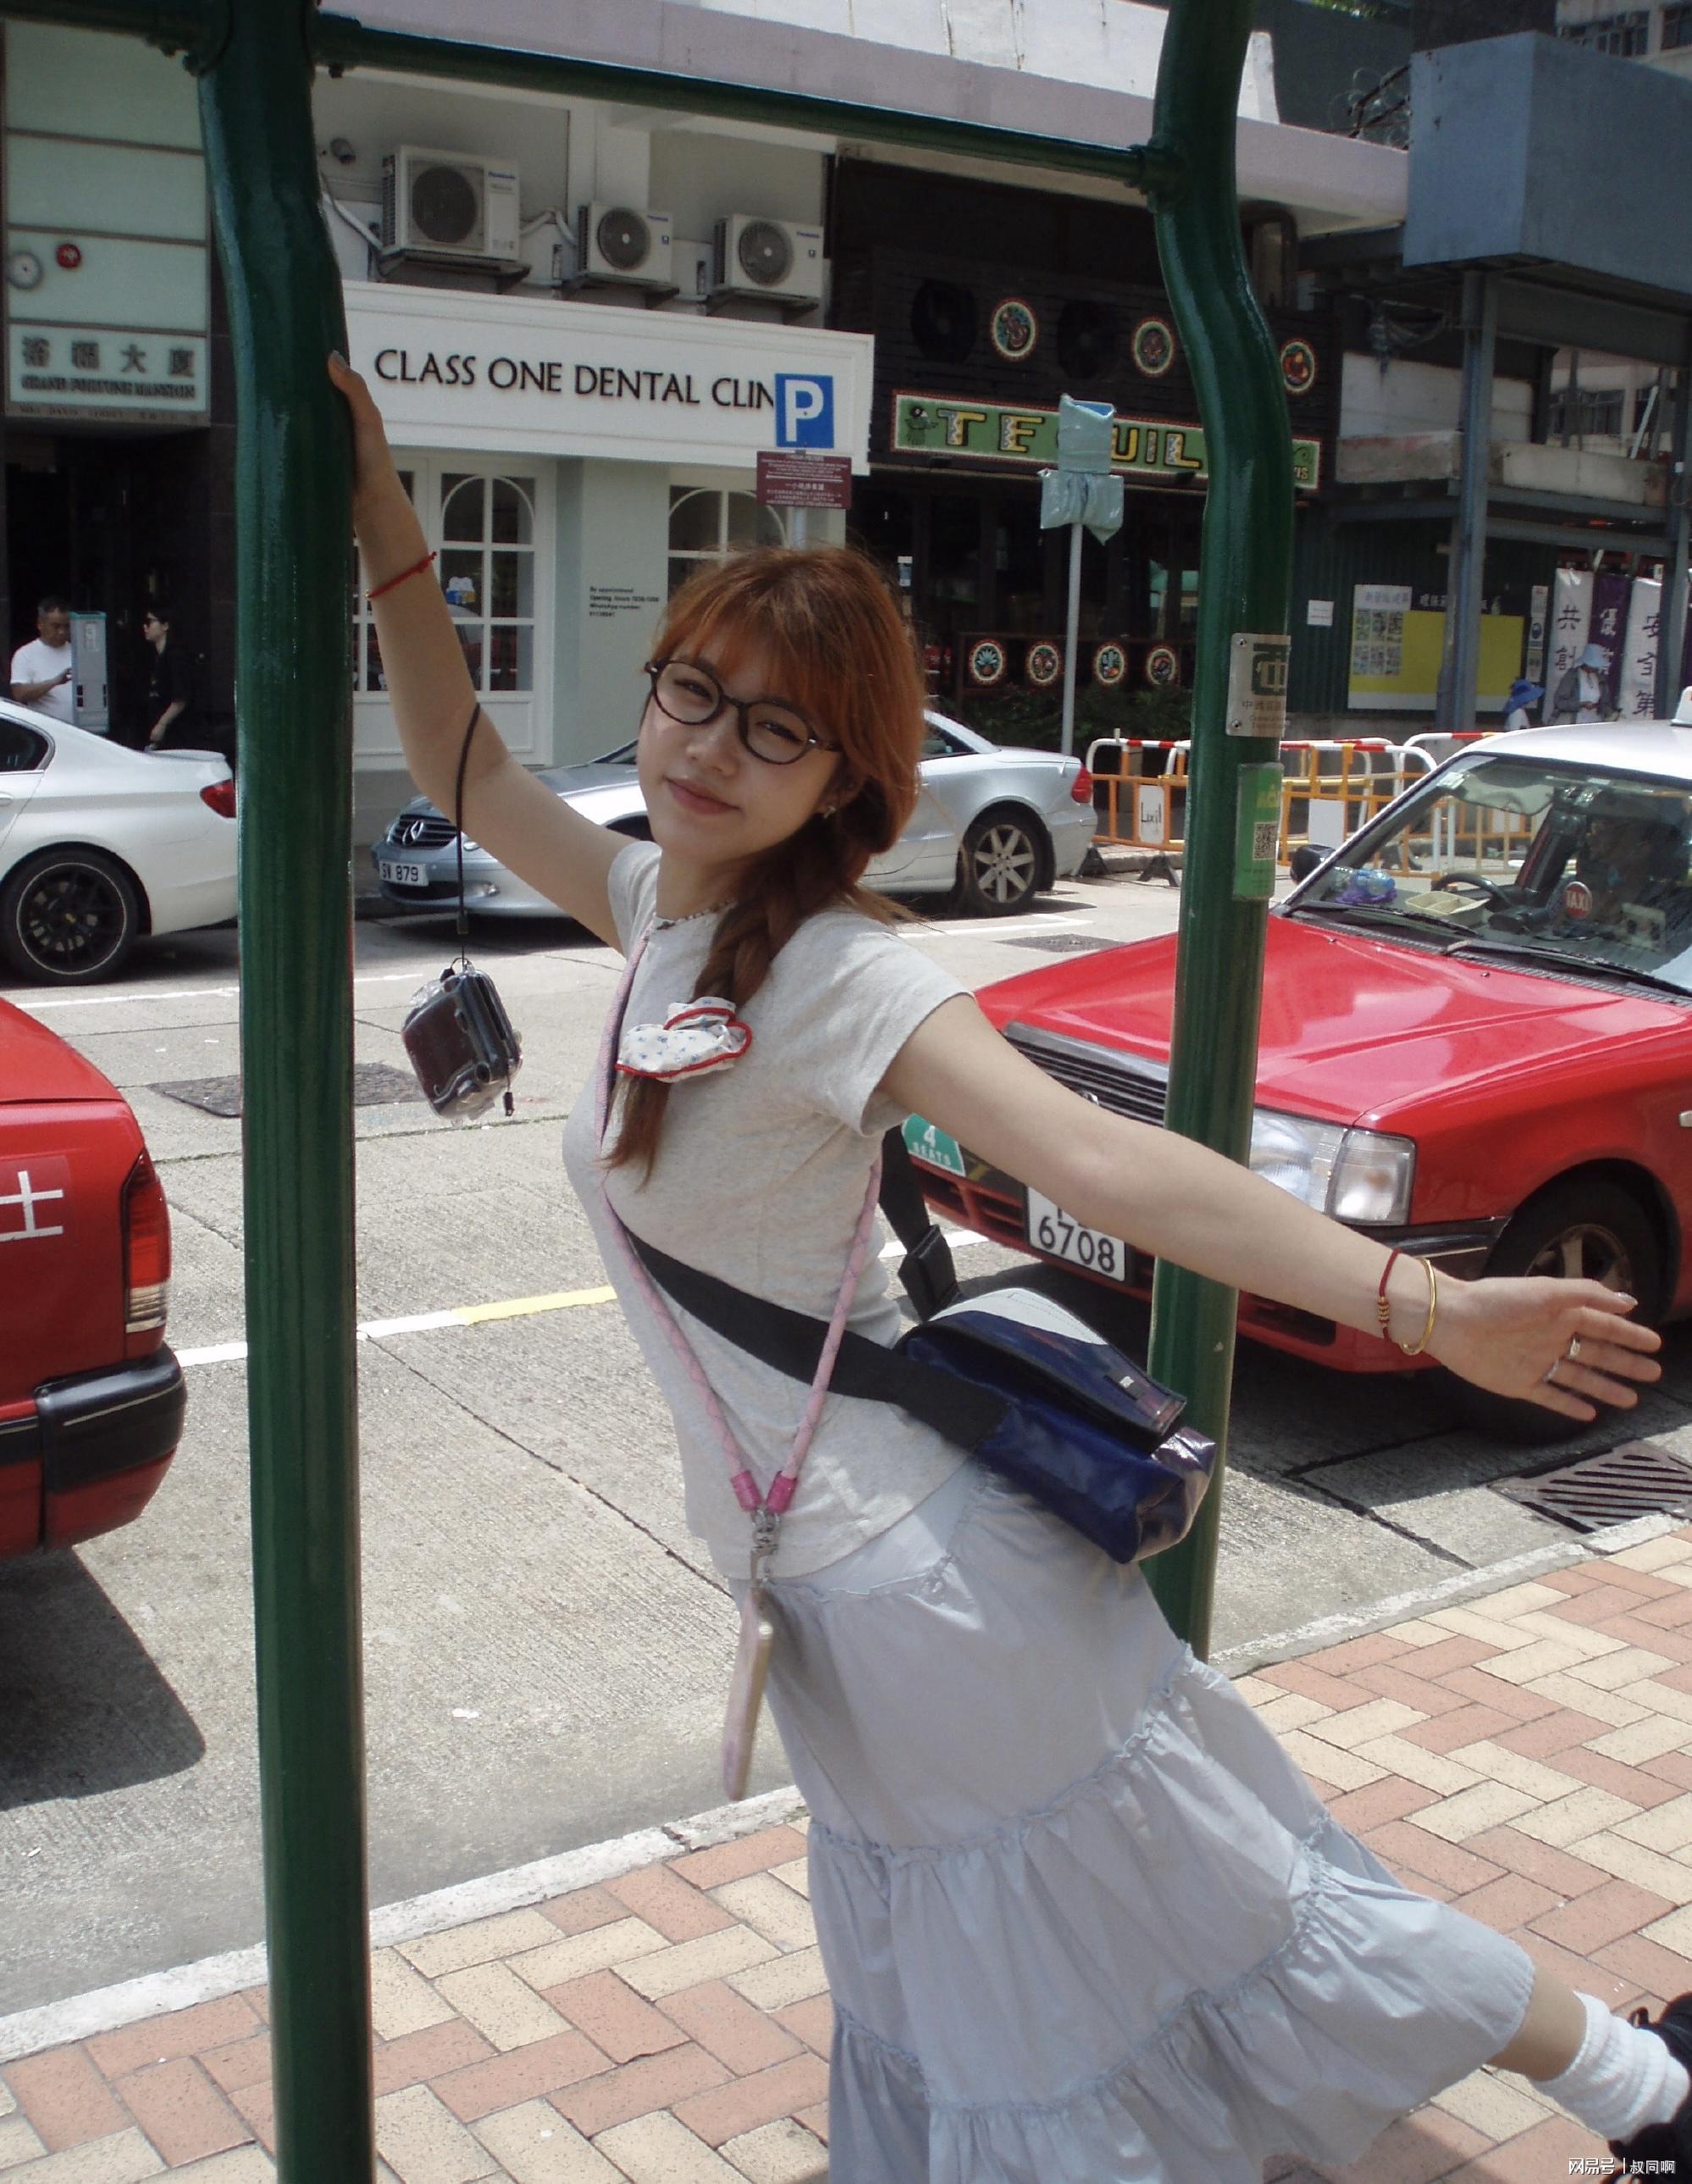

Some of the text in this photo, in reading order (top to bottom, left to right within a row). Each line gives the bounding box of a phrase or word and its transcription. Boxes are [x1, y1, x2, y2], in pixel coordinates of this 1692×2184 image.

[374, 349, 774, 411] CLASS ONE DENTAL CLIN
[784, 379, 824, 443] P
[937, 409, 1203, 470] TEUIL
[395, 865, 418, 882] 879
[1565, 890, 1591, 910] TAXI
[912, 1142, 951, 1166] SEATS
[923, 1125, 936, 1147] 4
[1039, 1216, 1115, 1273] 6708
